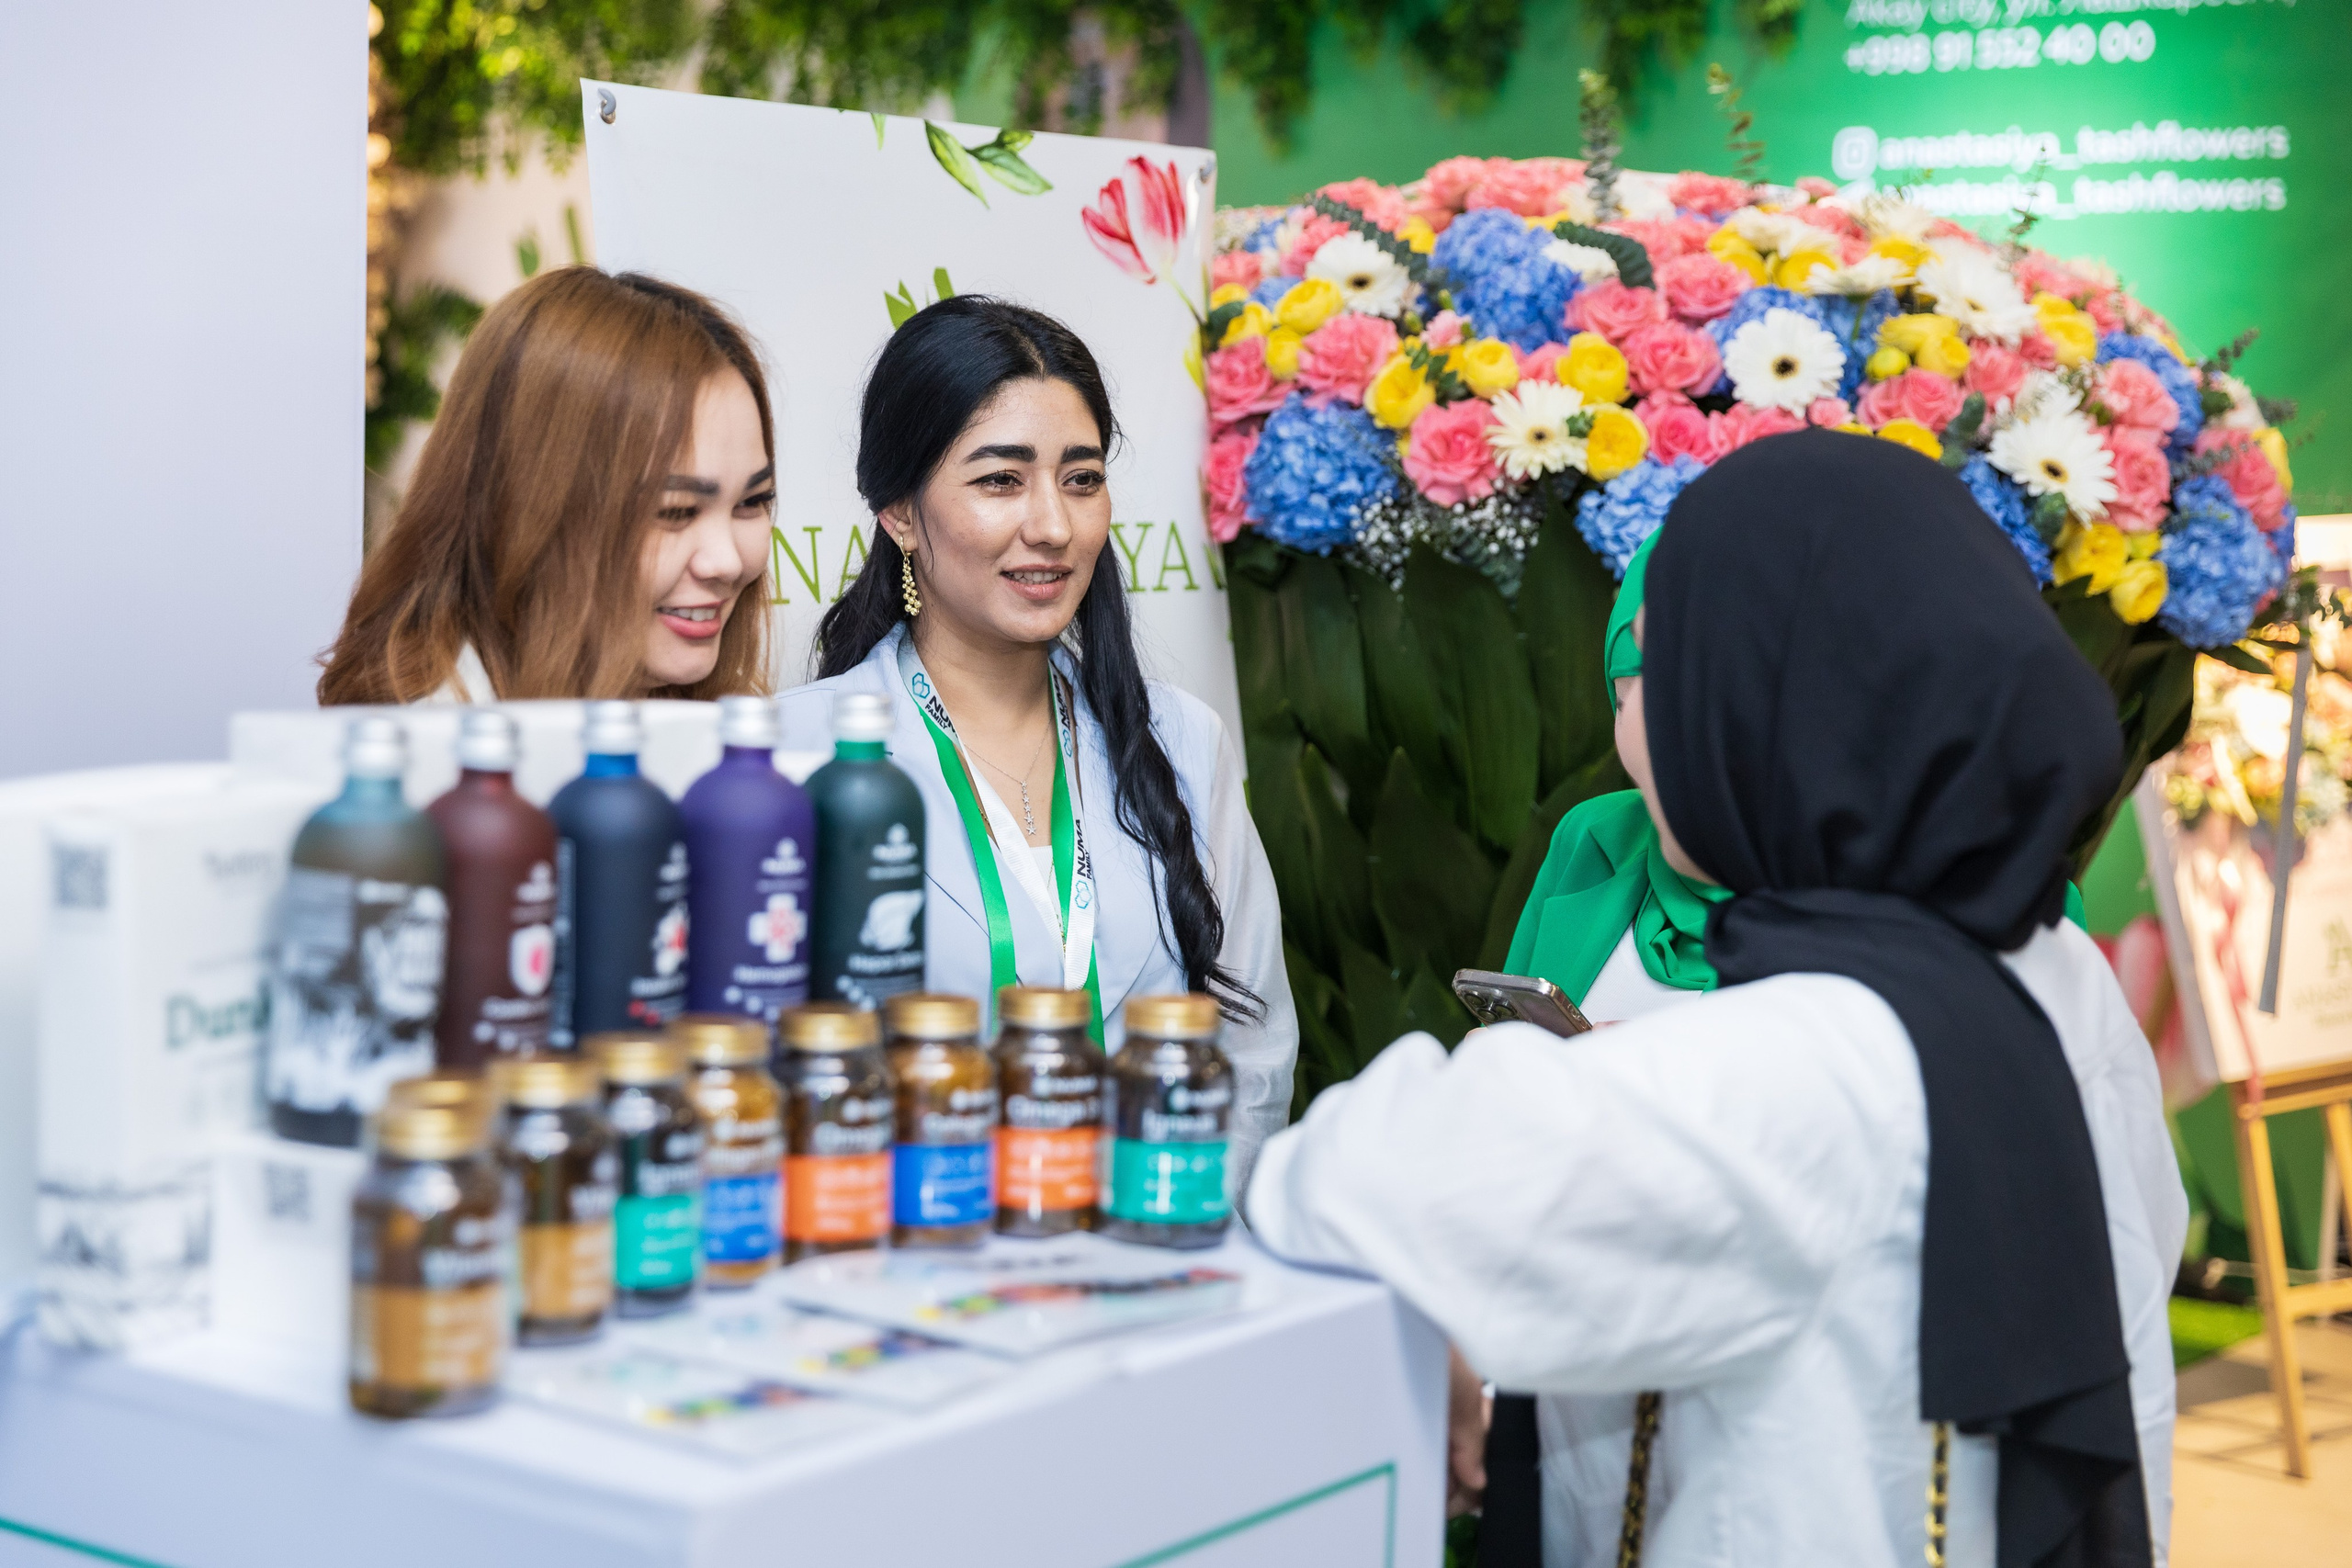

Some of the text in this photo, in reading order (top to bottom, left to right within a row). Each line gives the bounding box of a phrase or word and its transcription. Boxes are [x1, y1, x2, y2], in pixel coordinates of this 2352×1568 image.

[2098, 19, 2155, 63] 00
[924, 703, 947, 729] FAMILY
[1075, 818, 1086, 877] NUMA
